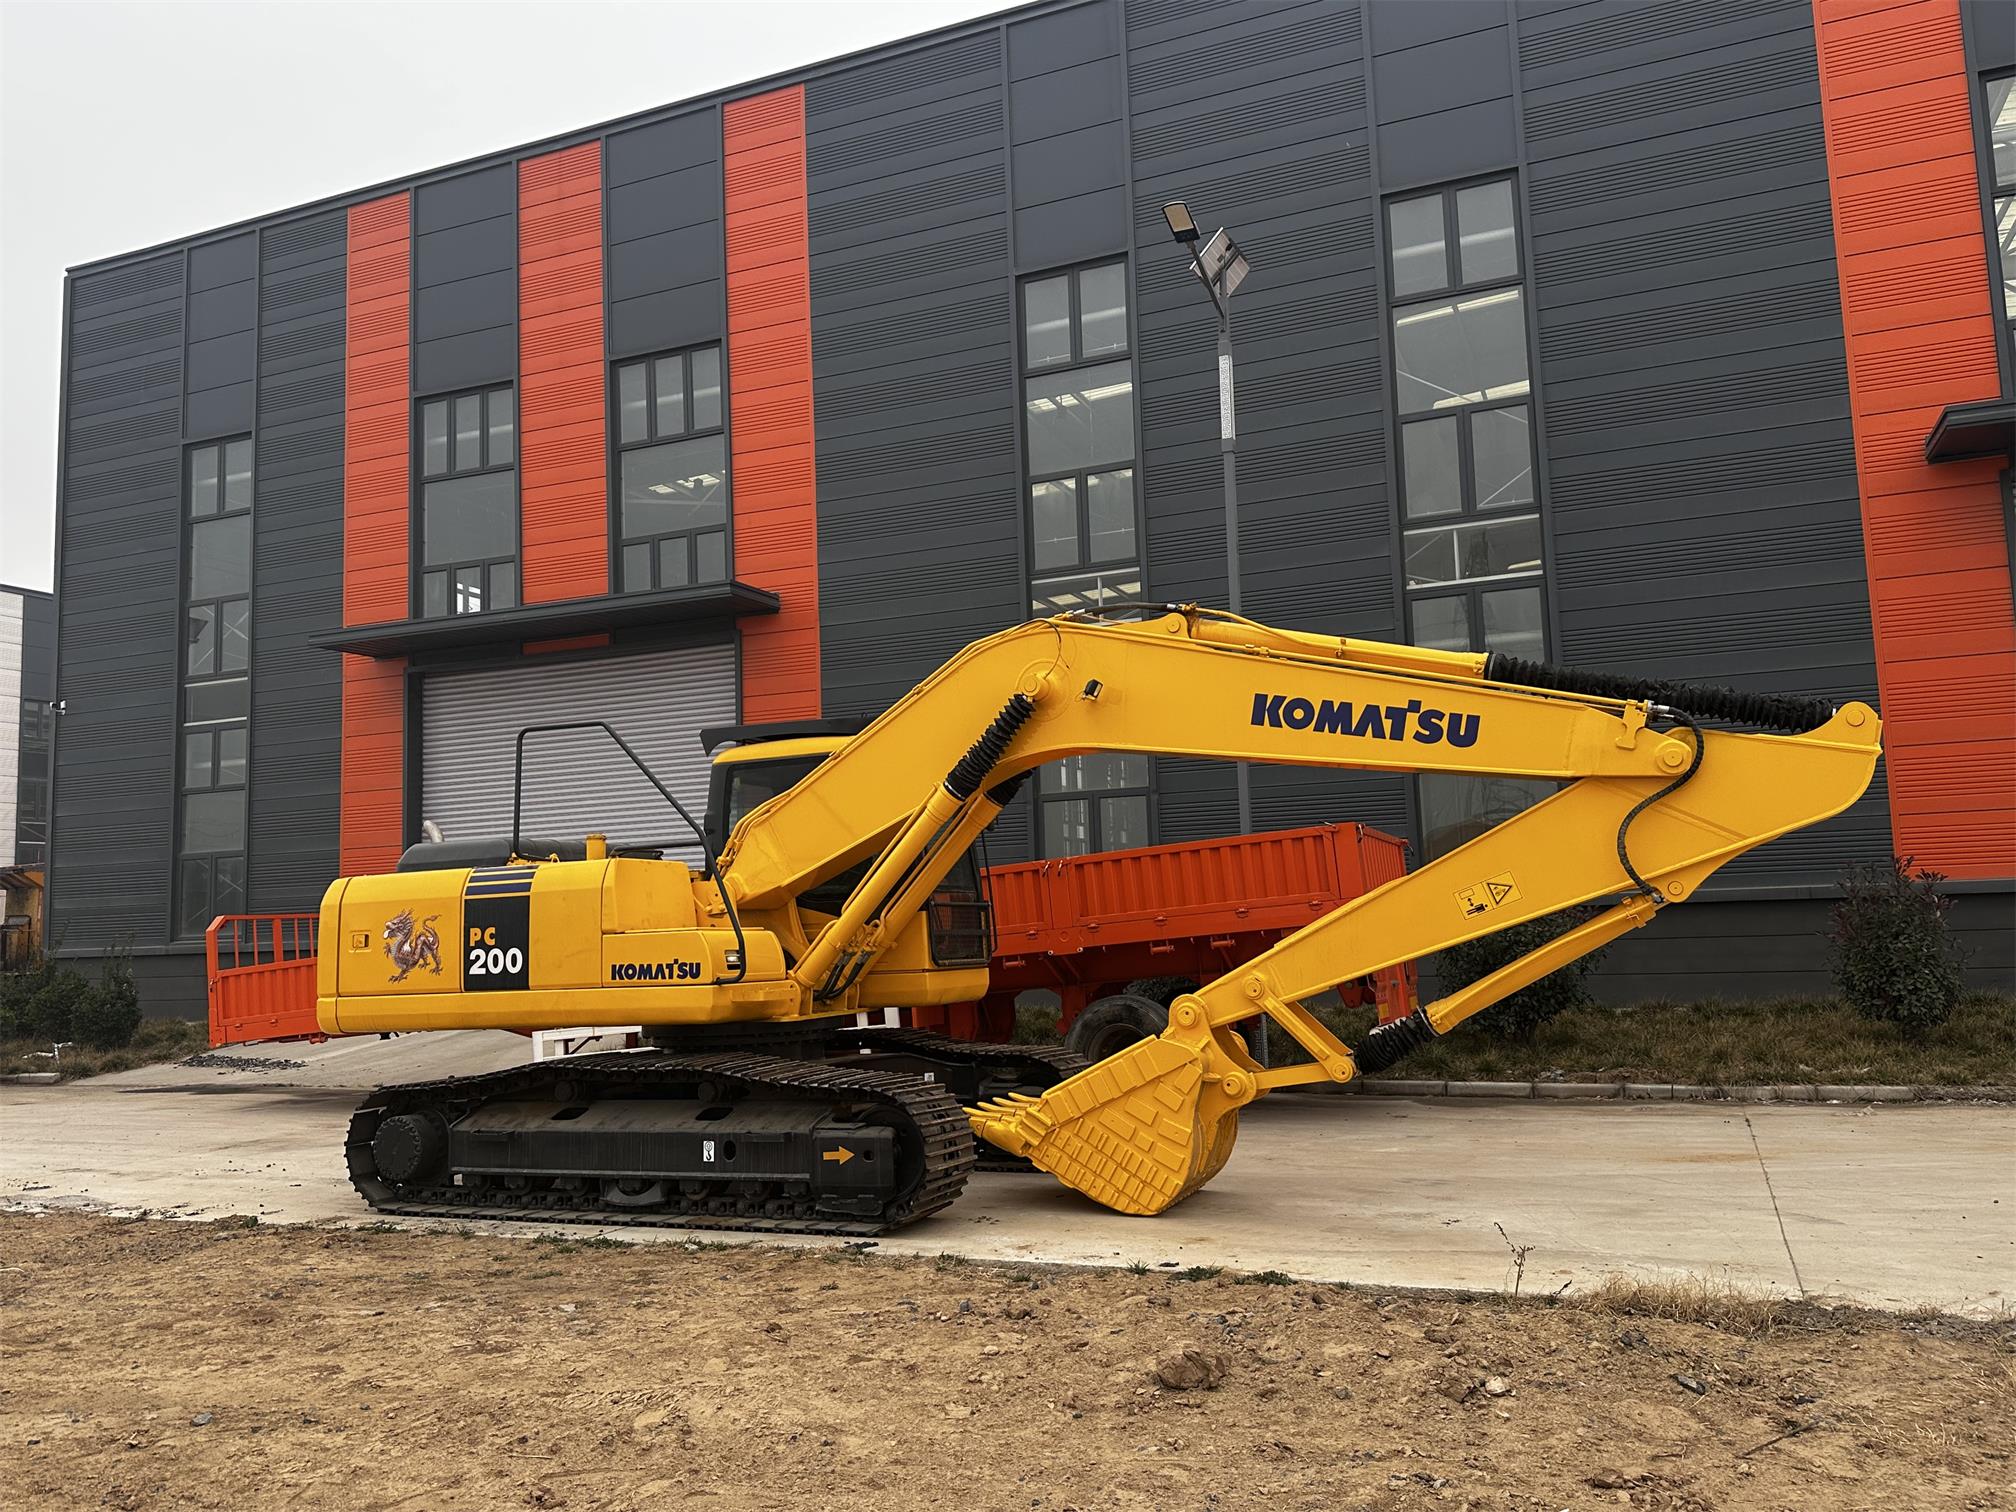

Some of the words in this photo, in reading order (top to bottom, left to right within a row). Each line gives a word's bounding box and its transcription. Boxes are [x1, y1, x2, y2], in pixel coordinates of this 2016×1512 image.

[1251, 693, 1481, 748] KOMATSU
[469, 926, 496, 947] PC
[468, 947, 523, 975] 200
[611, 958, 701, 981] KOMATSU
